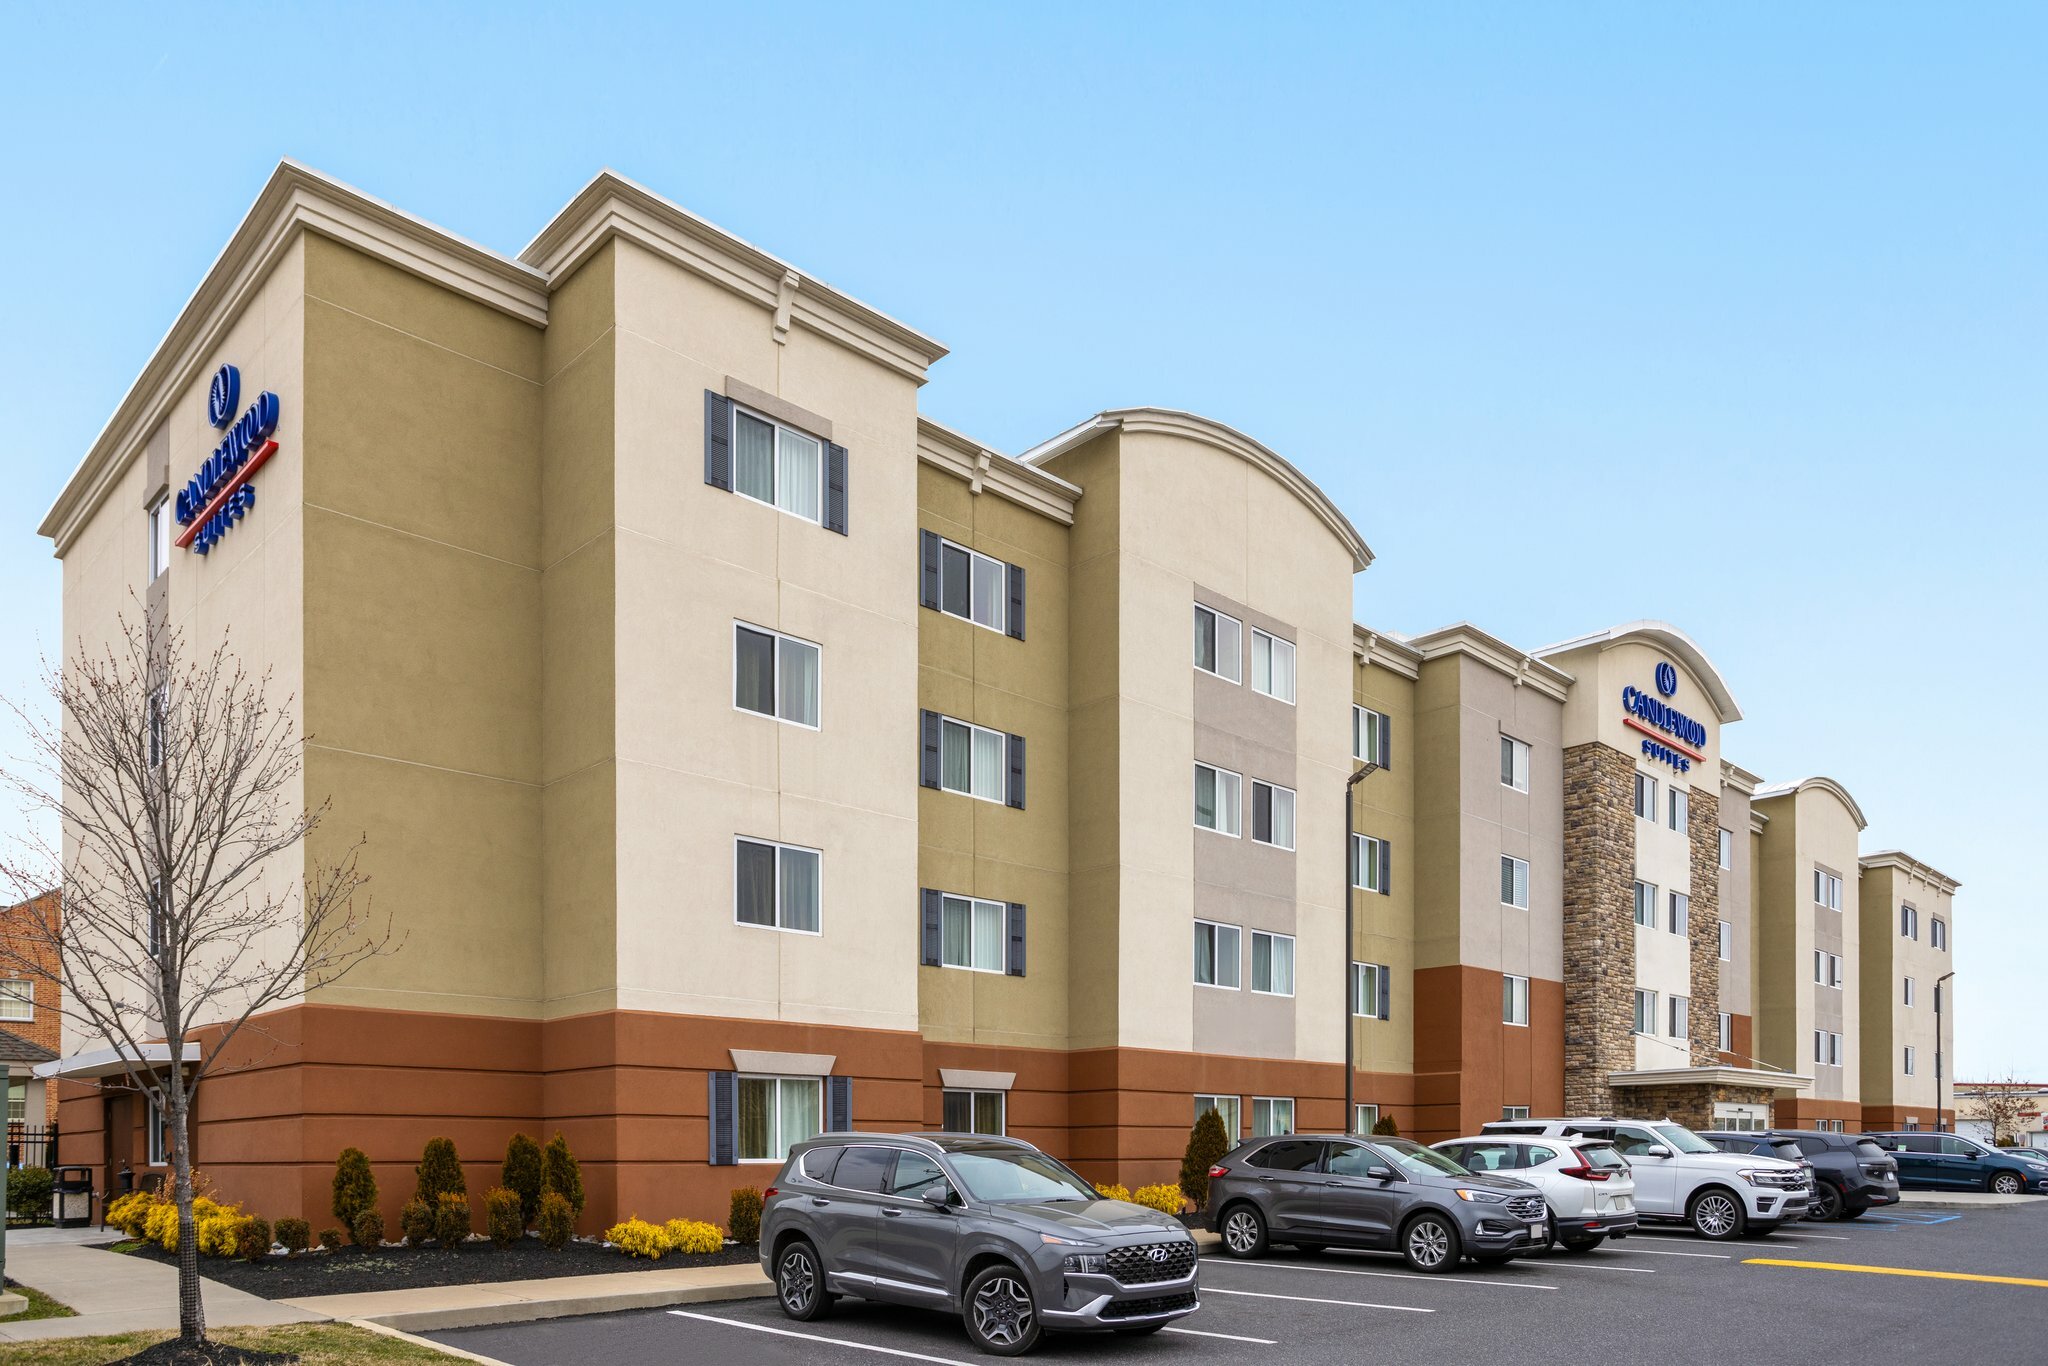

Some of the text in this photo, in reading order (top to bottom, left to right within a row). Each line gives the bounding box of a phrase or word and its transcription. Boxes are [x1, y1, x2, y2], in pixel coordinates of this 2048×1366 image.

[175, 391, 280, 527] CANDLEWOOD
[194, 483, 255, 556] SUITES
[1622, 685, 1707, 749] CANDLEWOOD
[1641, 738, 1691, 773] SUITES
